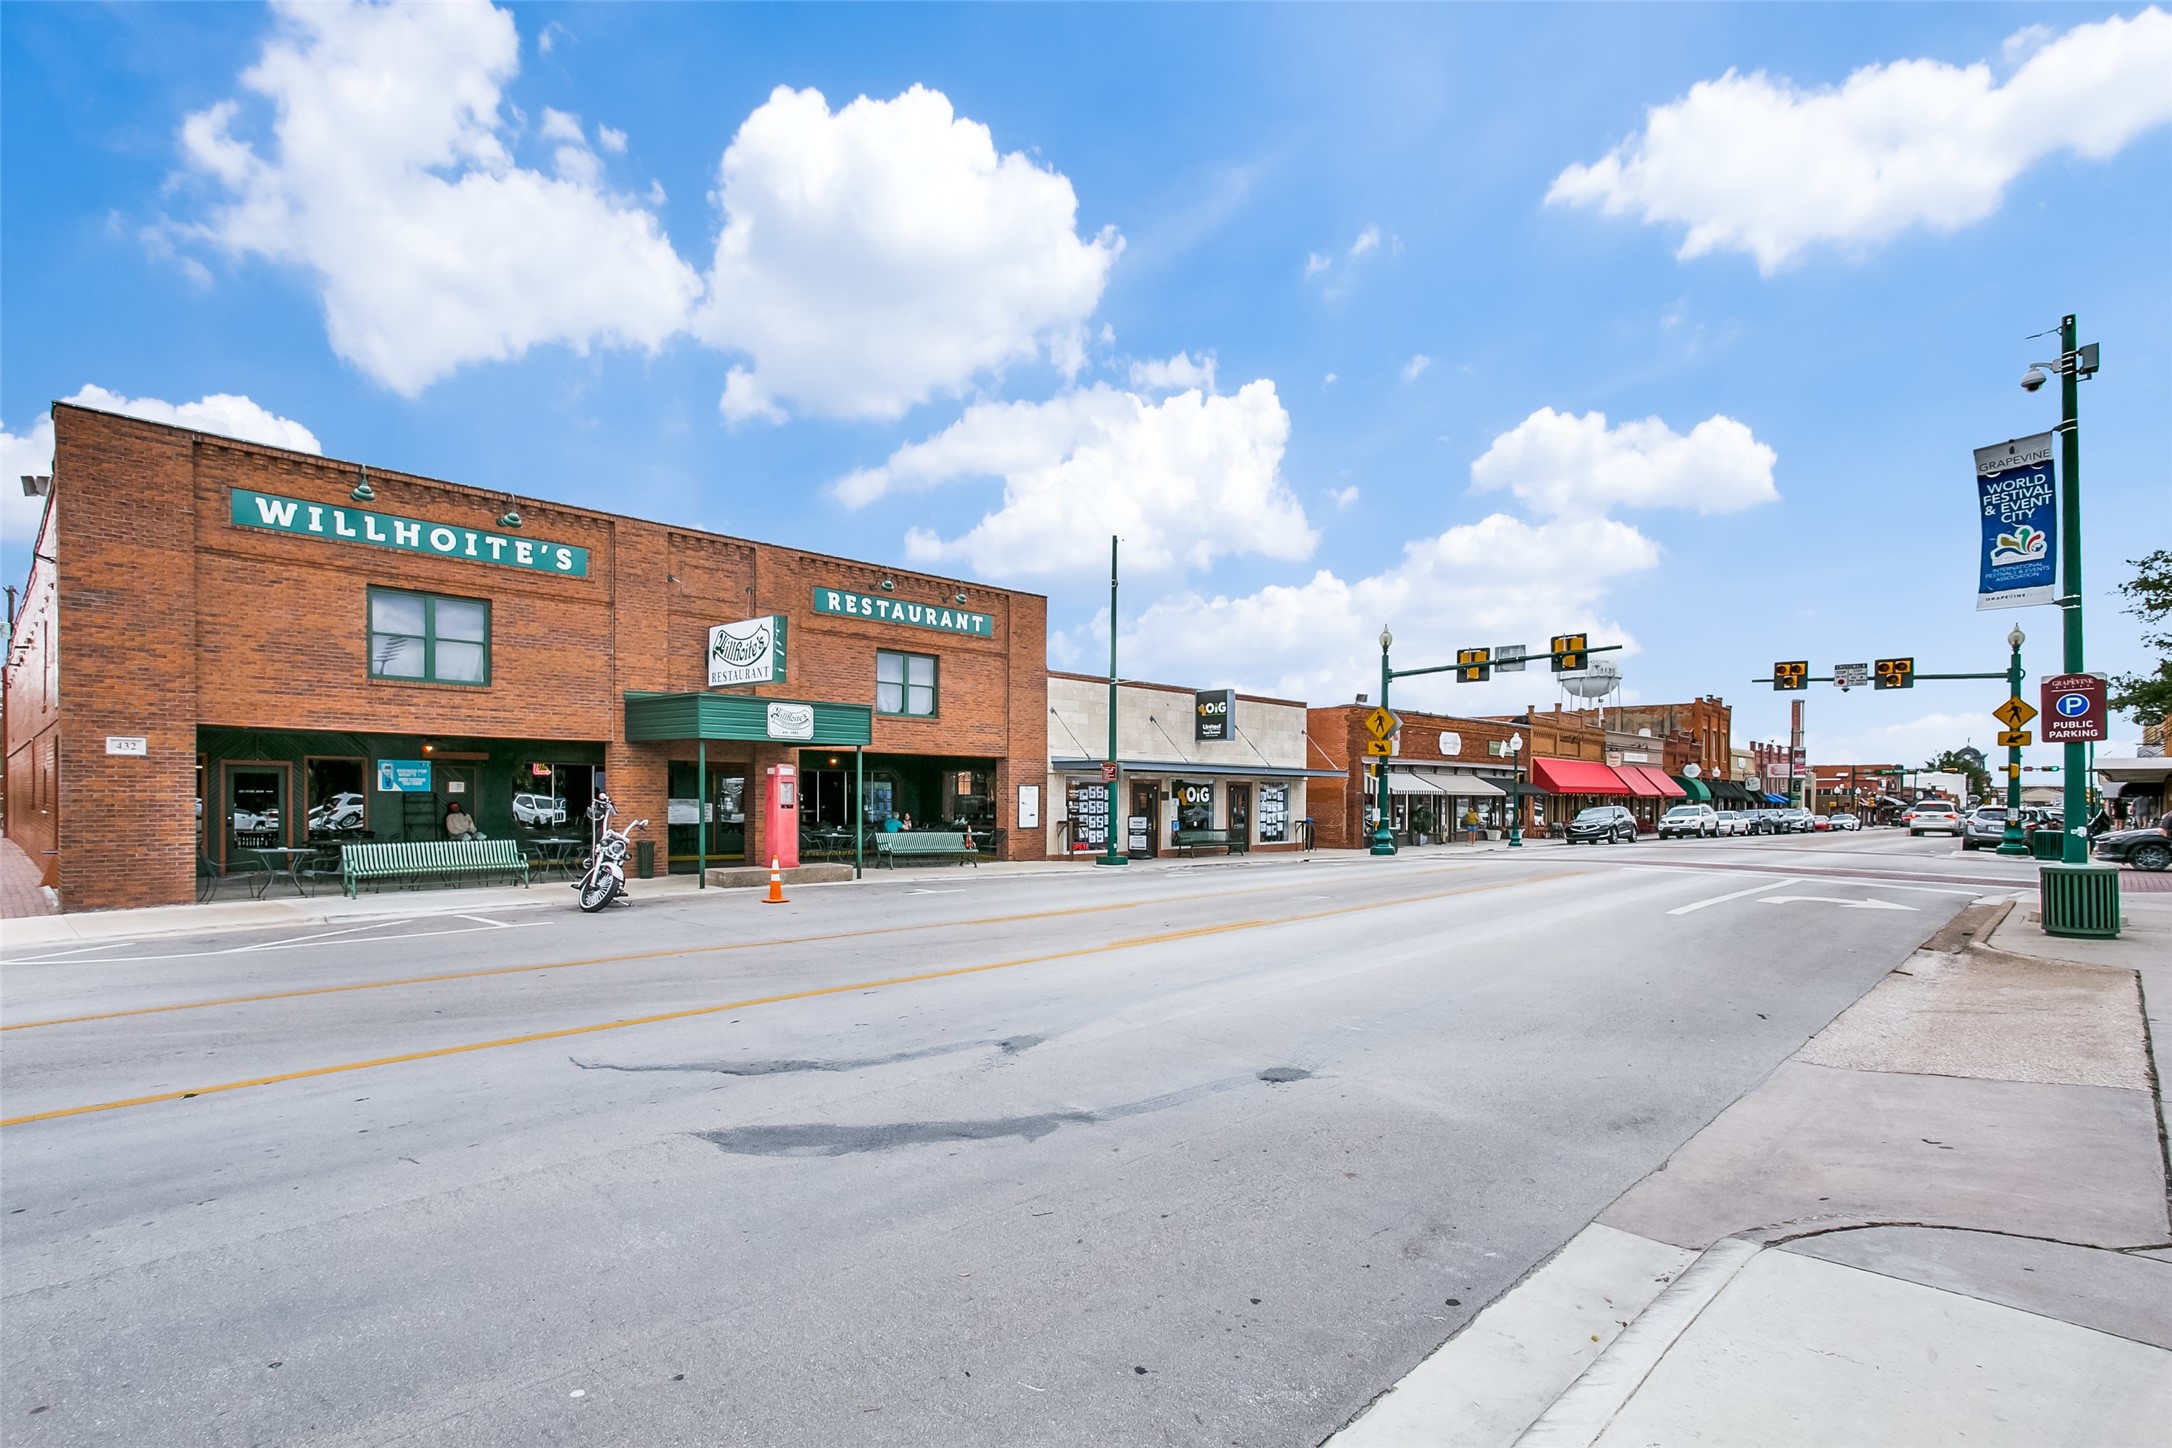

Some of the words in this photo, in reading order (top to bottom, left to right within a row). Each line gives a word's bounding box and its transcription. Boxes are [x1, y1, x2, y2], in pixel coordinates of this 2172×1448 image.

[1979, 449, 2050, 471] GRAPEVINE
[1987, 474, 2046, 493] WORLD
[1983, 484, 2053, 505] FESTIVAL
[1985, 506, 1996, 516] &
[2001, 494, 2052, 513] EVENT
[2001, 508, 2035, 523] CITY
[255, 497, 573, 571] WILLHOITE'S
[1985, 569, 2017, 579] FESTIVALS
[2025, 565, 2050, 573] EVENTS
[1992, 562, 2042, 573] INTERNATIONAL
[1995, 572, 2040, 582] ASSOCIATION
[827, 592, 984, 632] RESTAURANT
[711, 666, 770, 683] RESTAURANT
[2052, 678, 2094, 687] GRAPEVINE
[2066, 697, 2083, 714] P
[2053, 720, 2094, 729] PUBLIC
[2049, 729, 2098, 739] PARKING
[116, 742, 137, 750] 432
